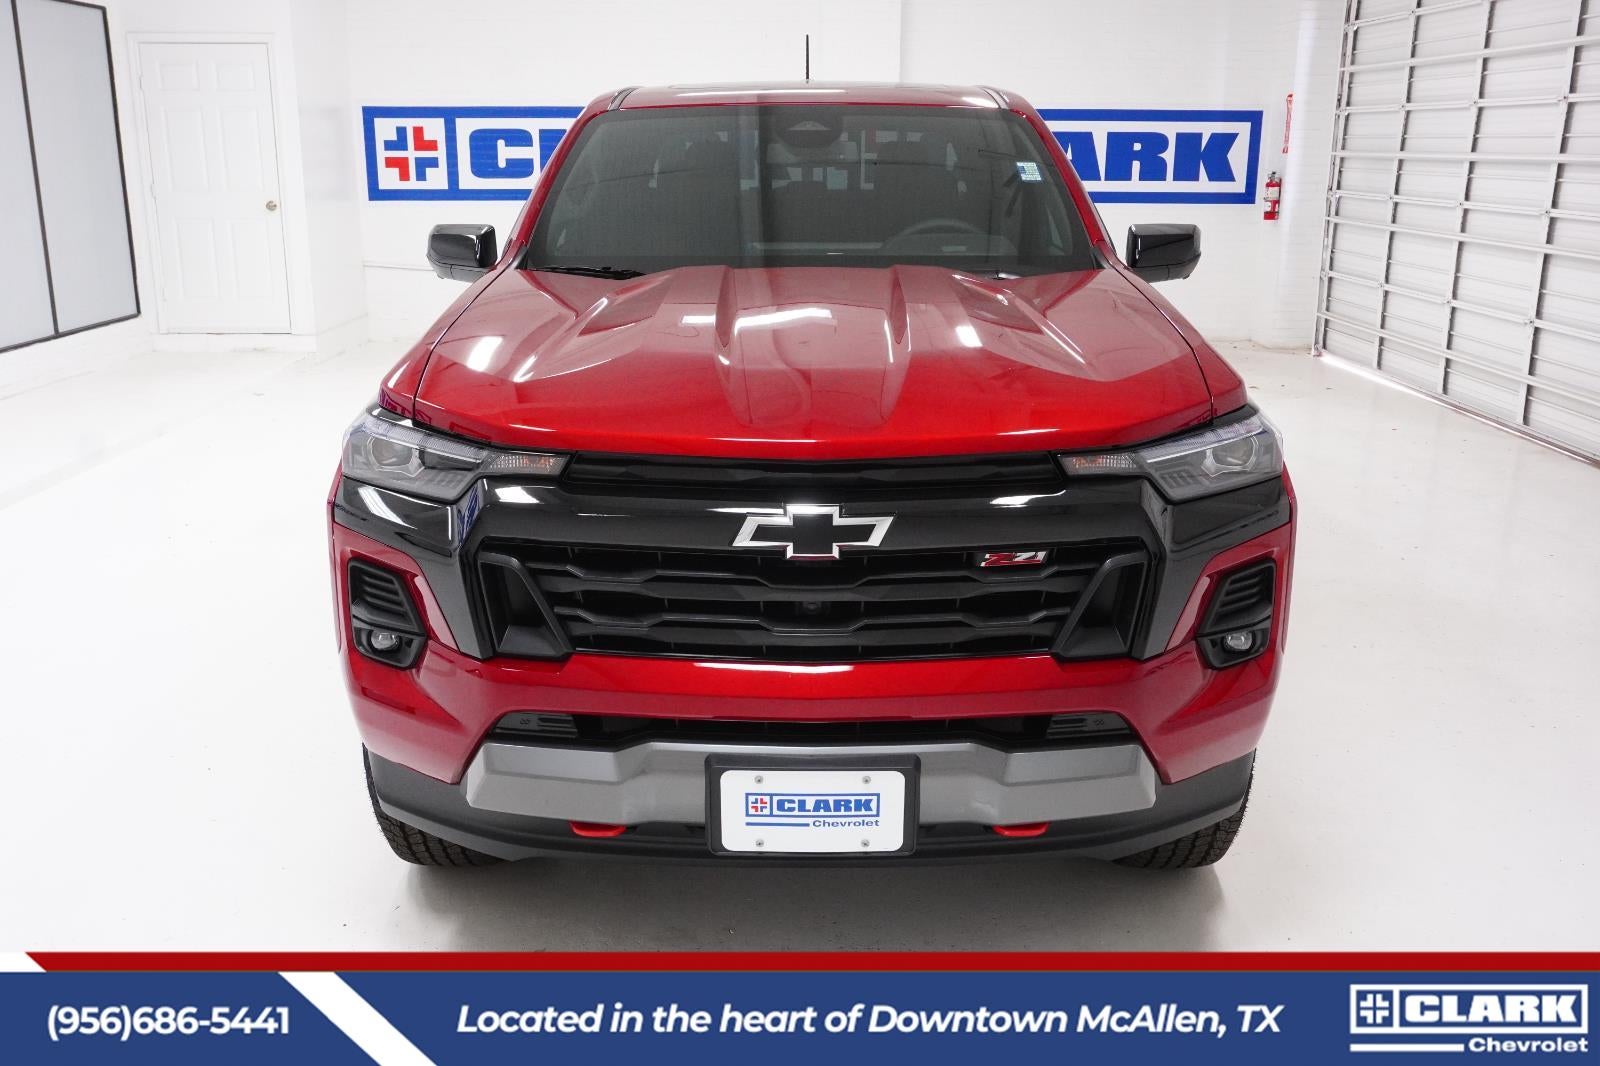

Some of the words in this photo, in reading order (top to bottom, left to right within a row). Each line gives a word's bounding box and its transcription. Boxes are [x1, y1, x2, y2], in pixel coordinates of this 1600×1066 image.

[980, 551, 1047, 567] Z71
[776, 798, 874, 813] CLARK
[812, 819, 880, 828] Chevrolet
